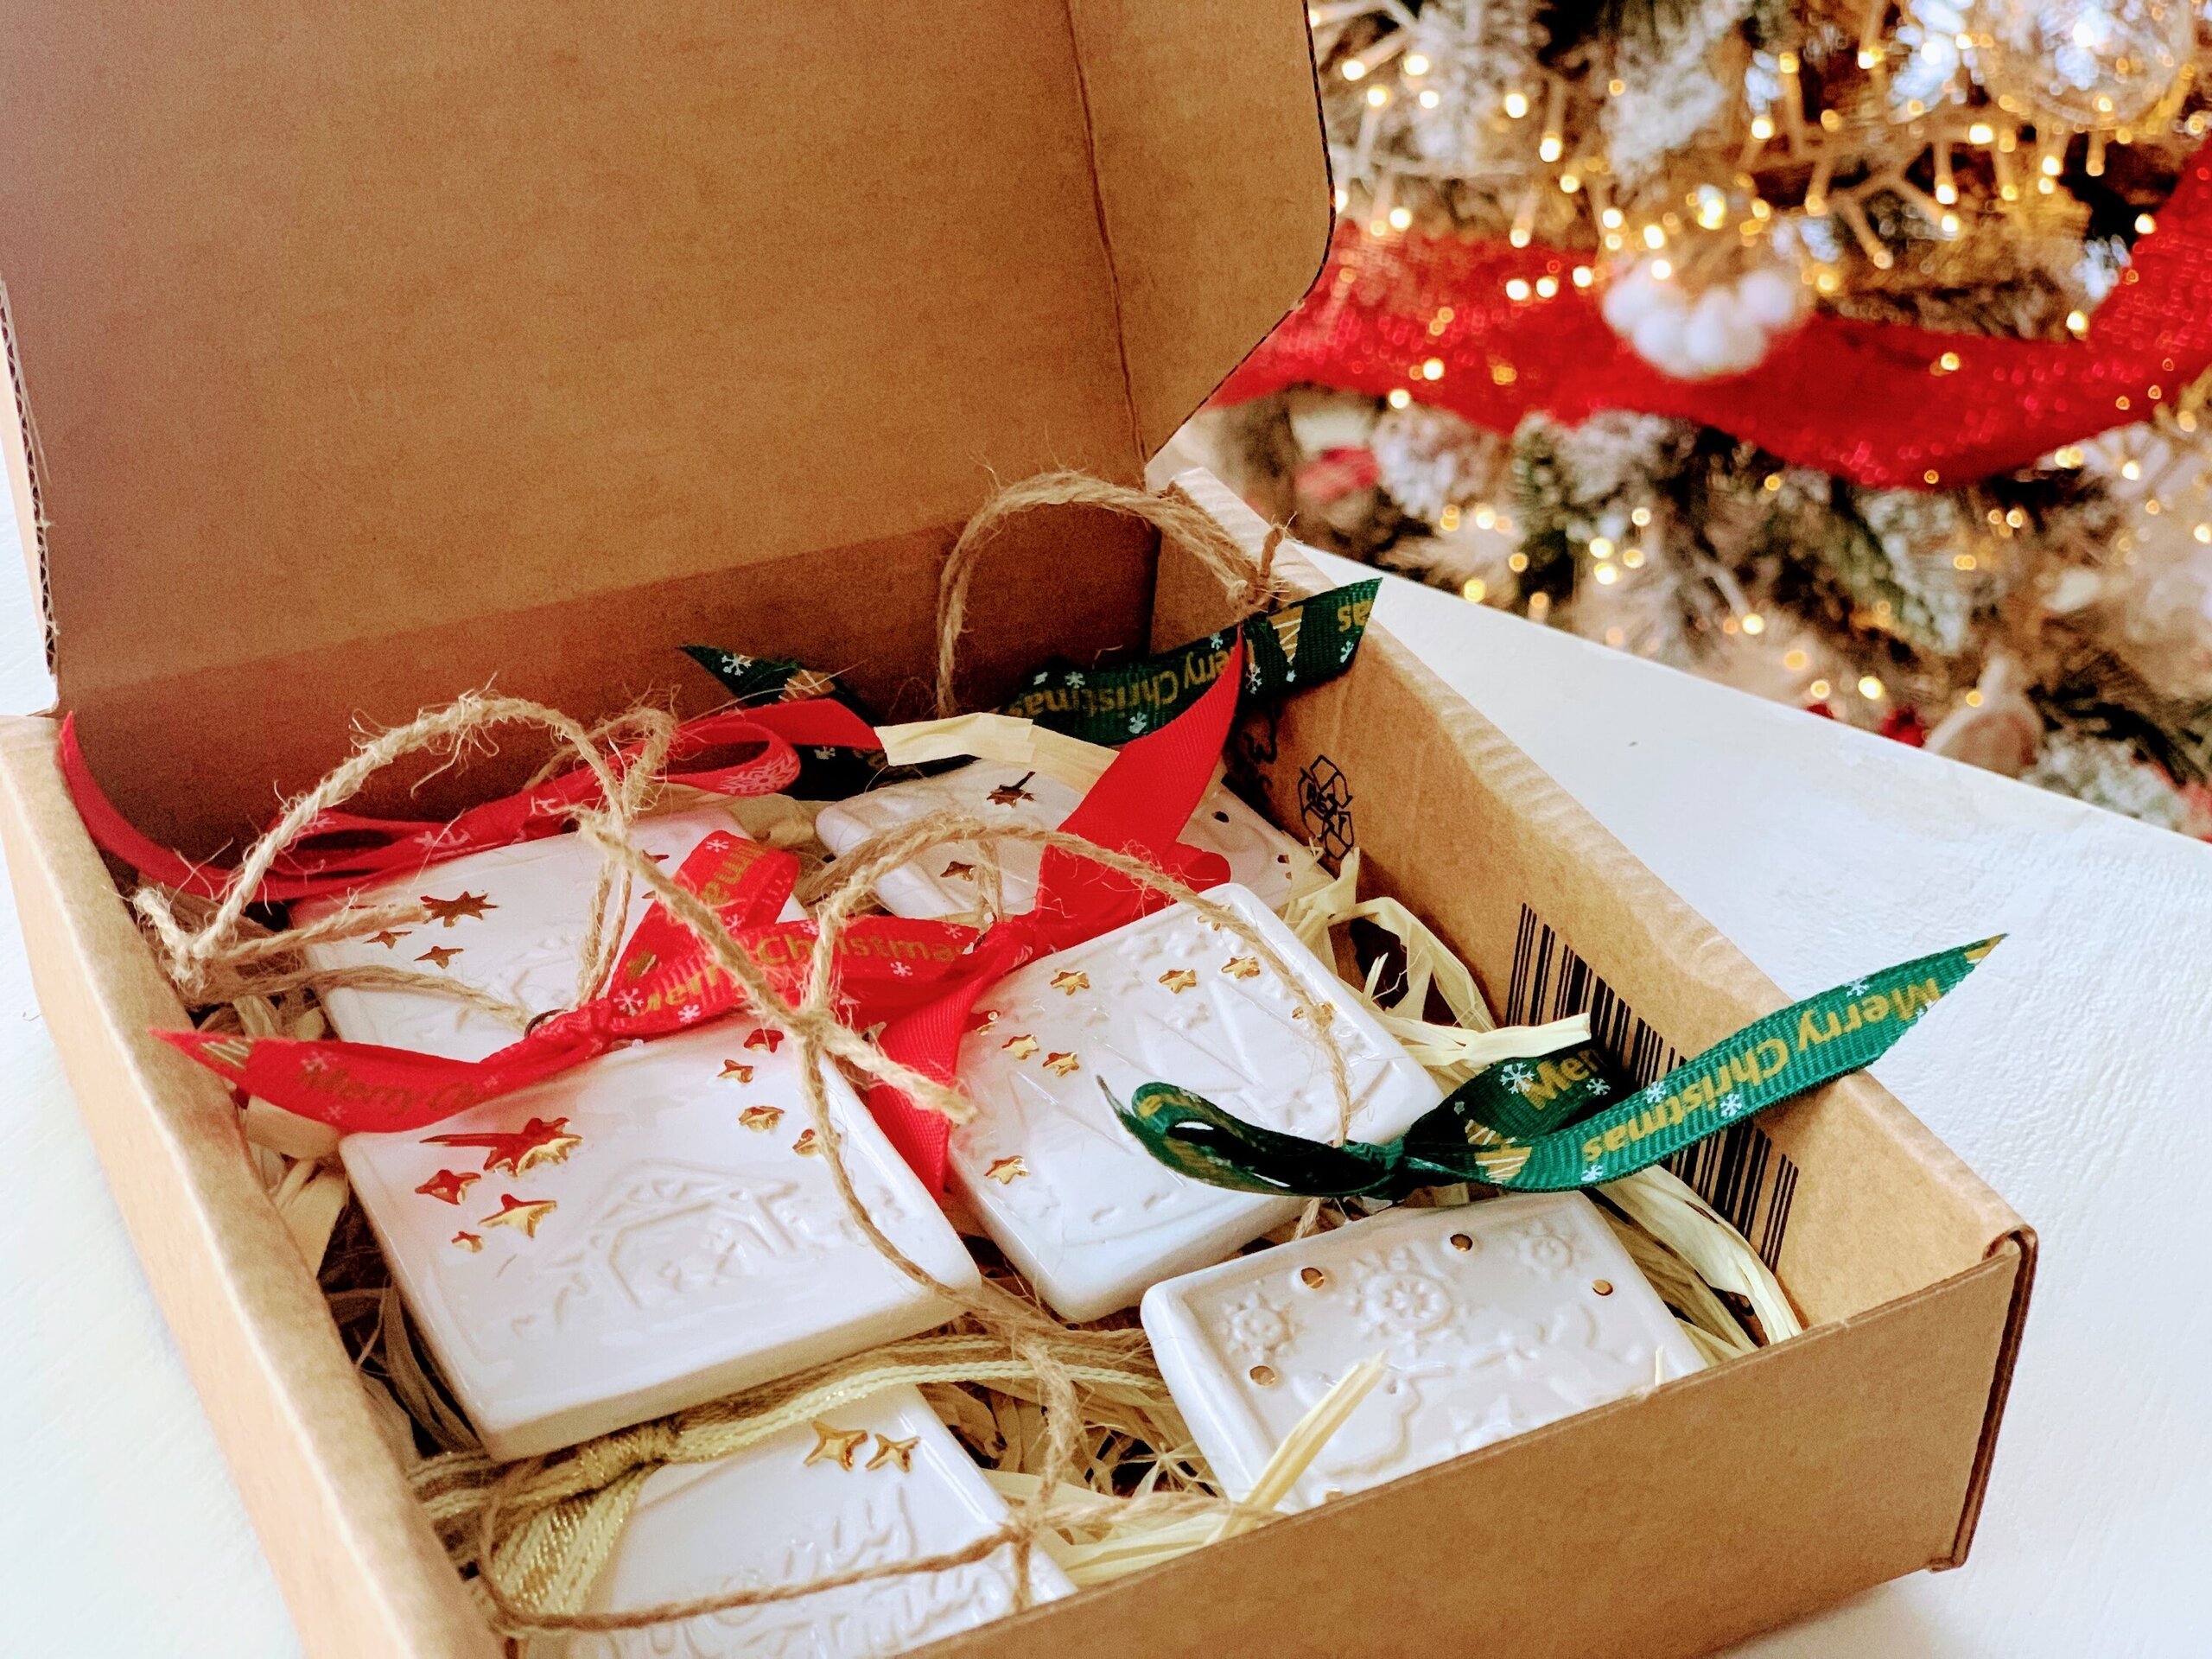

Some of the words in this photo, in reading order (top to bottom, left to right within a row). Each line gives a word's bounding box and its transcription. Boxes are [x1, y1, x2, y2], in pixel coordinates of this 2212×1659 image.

[1184, 643, 1236, 690] erry
[753, 932, 964, 965] Chistma
[1799, 978, 1942, 1052] Merry
[1583, 1038, 1789, 1162] Christmas
